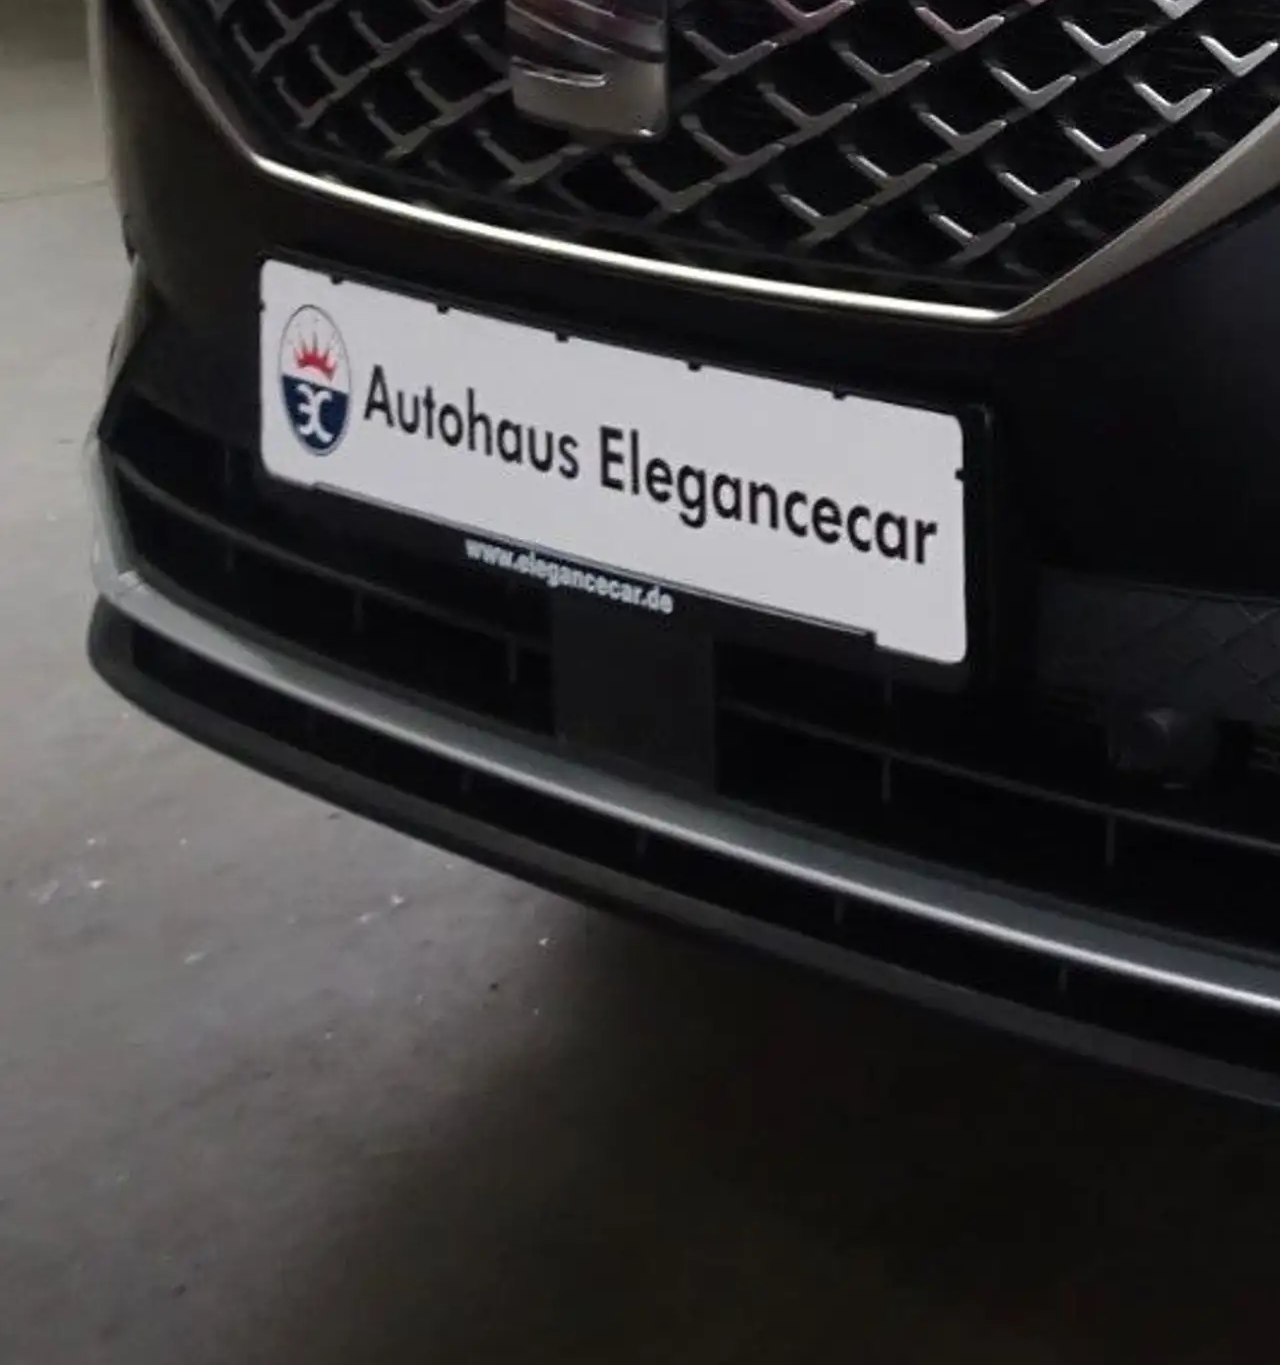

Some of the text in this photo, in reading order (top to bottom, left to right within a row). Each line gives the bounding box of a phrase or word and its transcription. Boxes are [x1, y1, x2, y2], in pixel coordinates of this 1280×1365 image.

[363, 363, 938, 565] Autohaus Elegancecar
[465, 537, 675, 615] www.elegancecar.de
